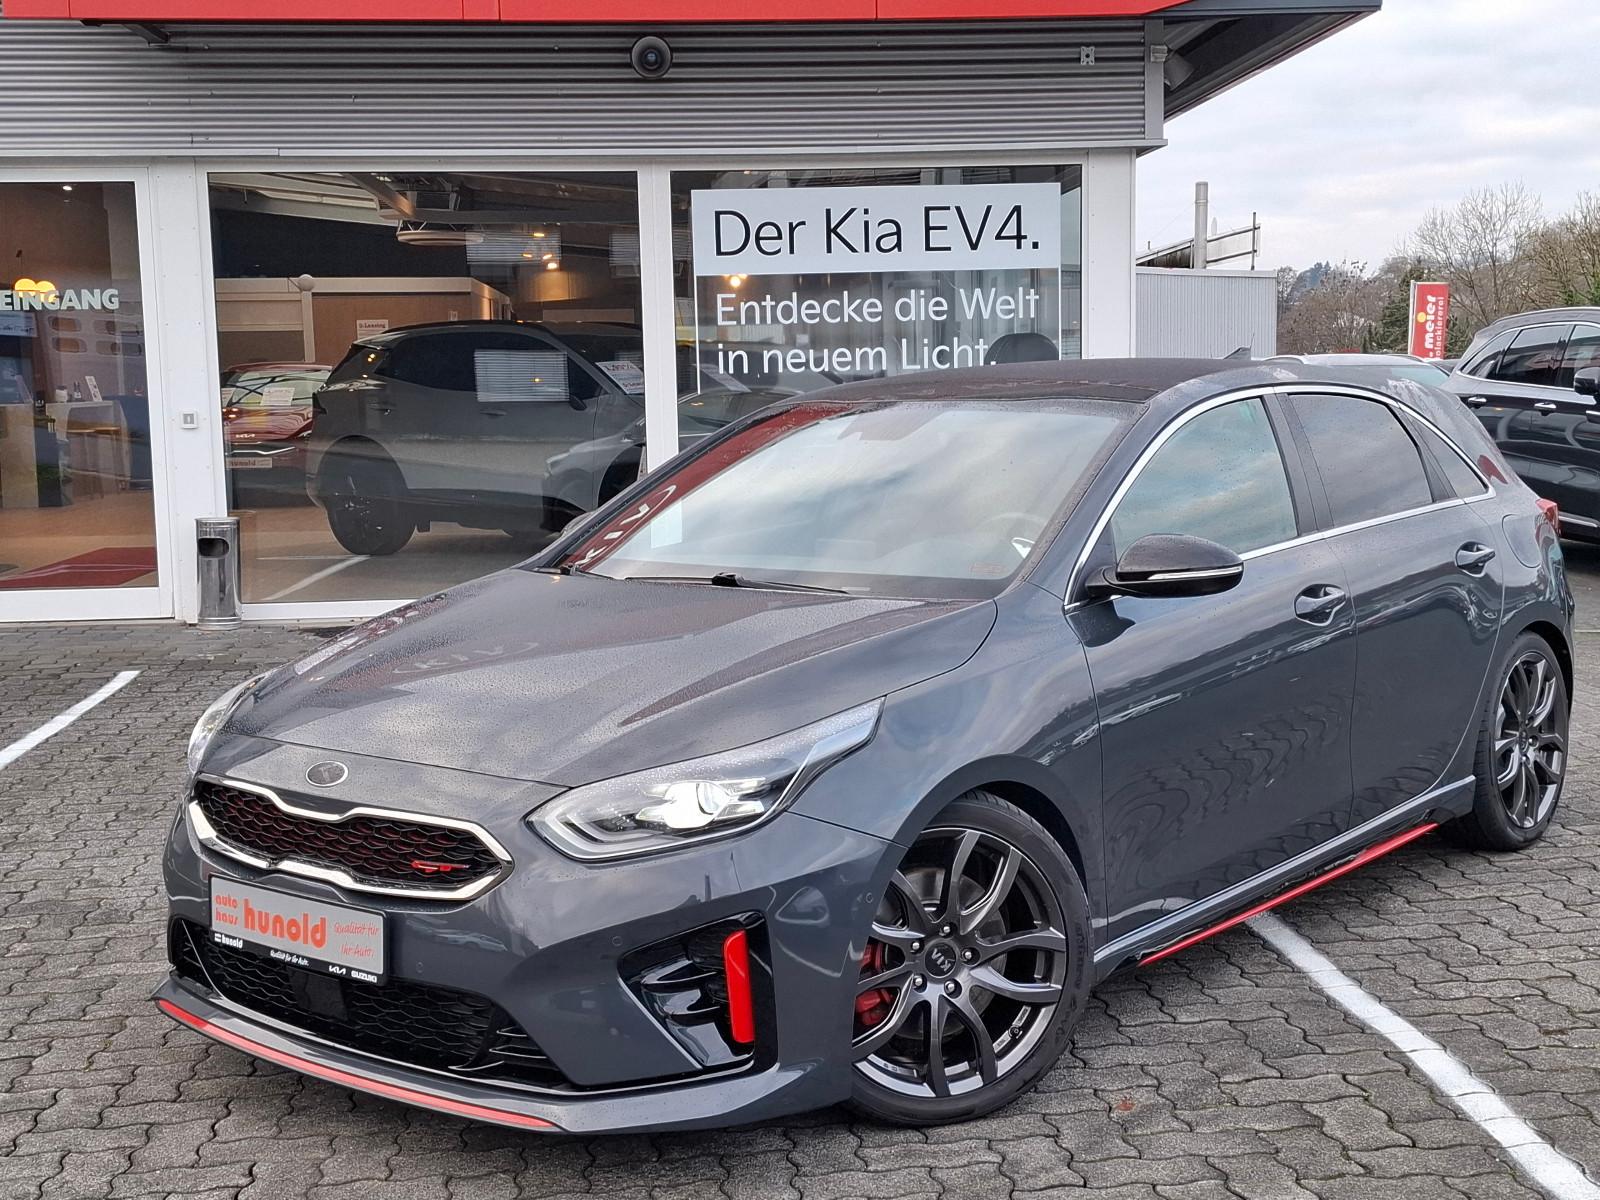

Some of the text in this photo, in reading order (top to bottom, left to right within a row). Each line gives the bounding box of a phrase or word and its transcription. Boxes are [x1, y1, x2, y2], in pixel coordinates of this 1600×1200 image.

[714, 204, 1041, 257] Der Kia EV4.
[0, 288, 119, 310] EINGANG
[716, 287, 1040, 327] Entdecke die Welt
[1417, 295, 1436, 349] meier
[1434, 297, 1445, 358] olackiererei
[718, 337, 997, 375] in neuem Licht.
[215, 894, 239, 909] auto
[215, 909, 239, 926] haus
[243, 899, 327, 949] hunold
[221, 934, 243, 949] hunold
[328, 964, 378, 984] KIA SUZUKI
[931, 947, 952, 972] KIA
